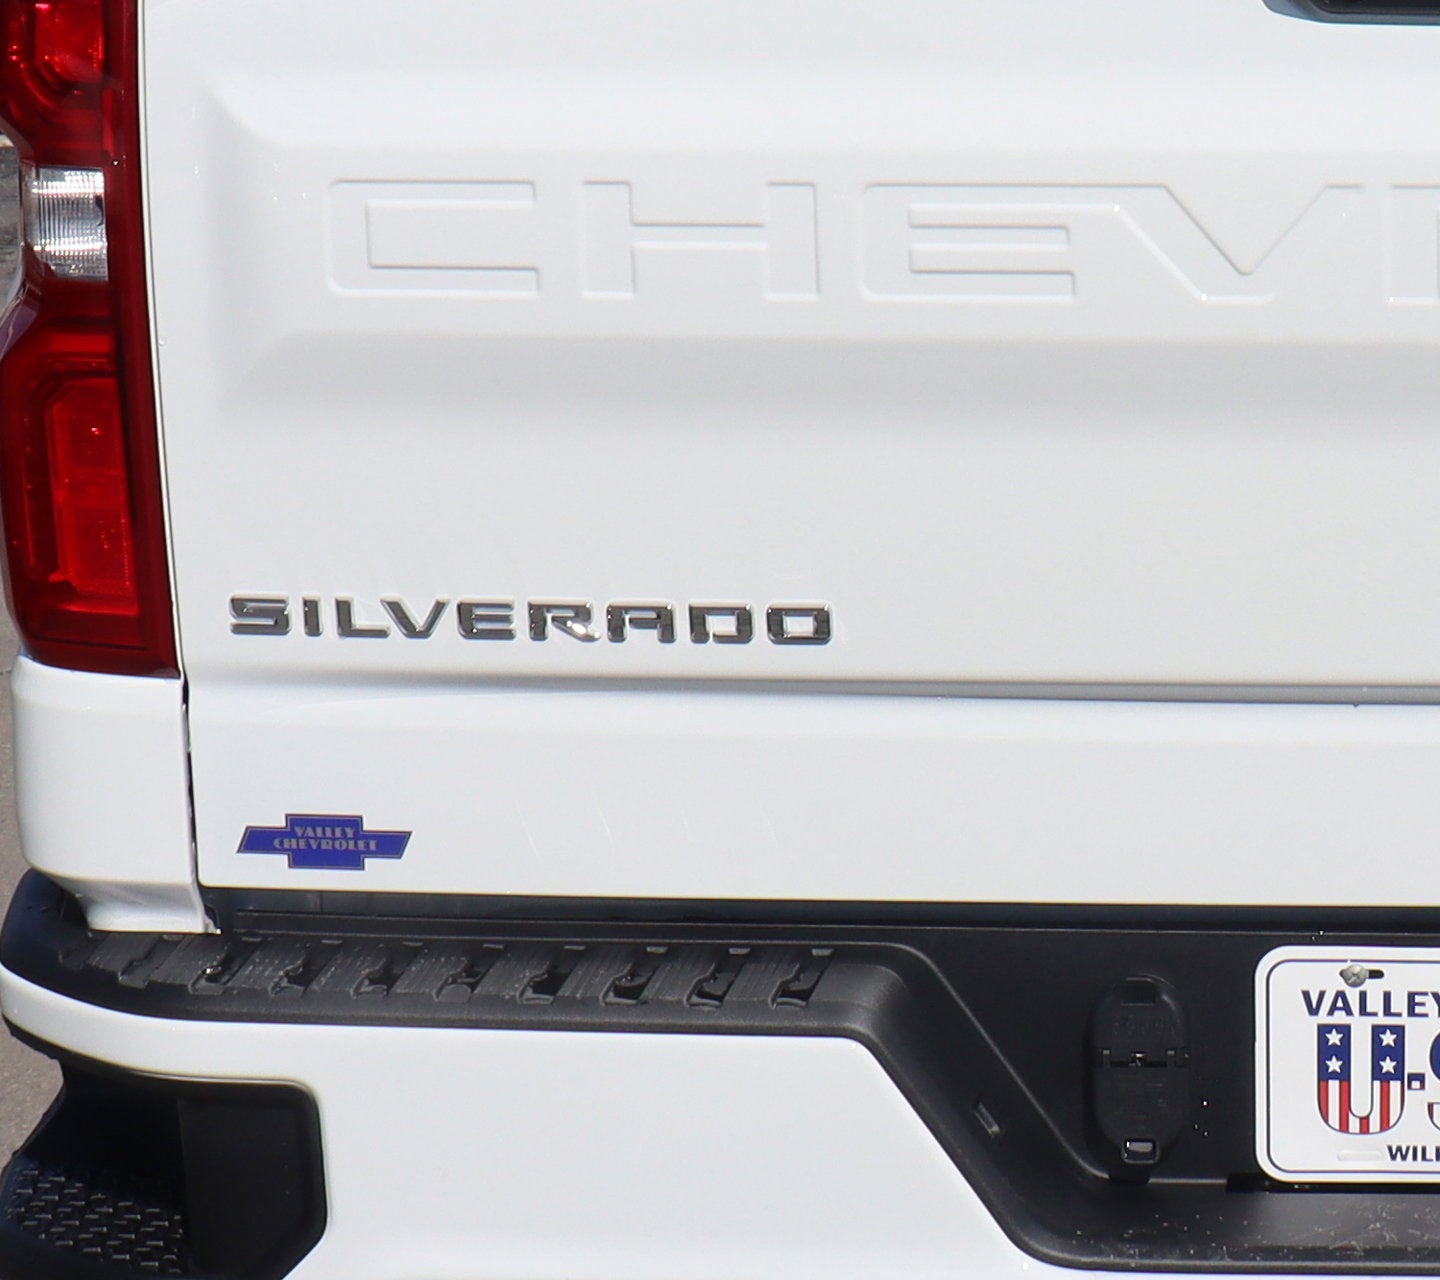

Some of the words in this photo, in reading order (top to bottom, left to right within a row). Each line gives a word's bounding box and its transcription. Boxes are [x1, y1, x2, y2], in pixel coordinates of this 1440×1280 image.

[229, 594, 834, 645] SILVERADO
[295, 826, 355, 837] VALLEY
[274, 838, 377, 851] CHEVROLET
